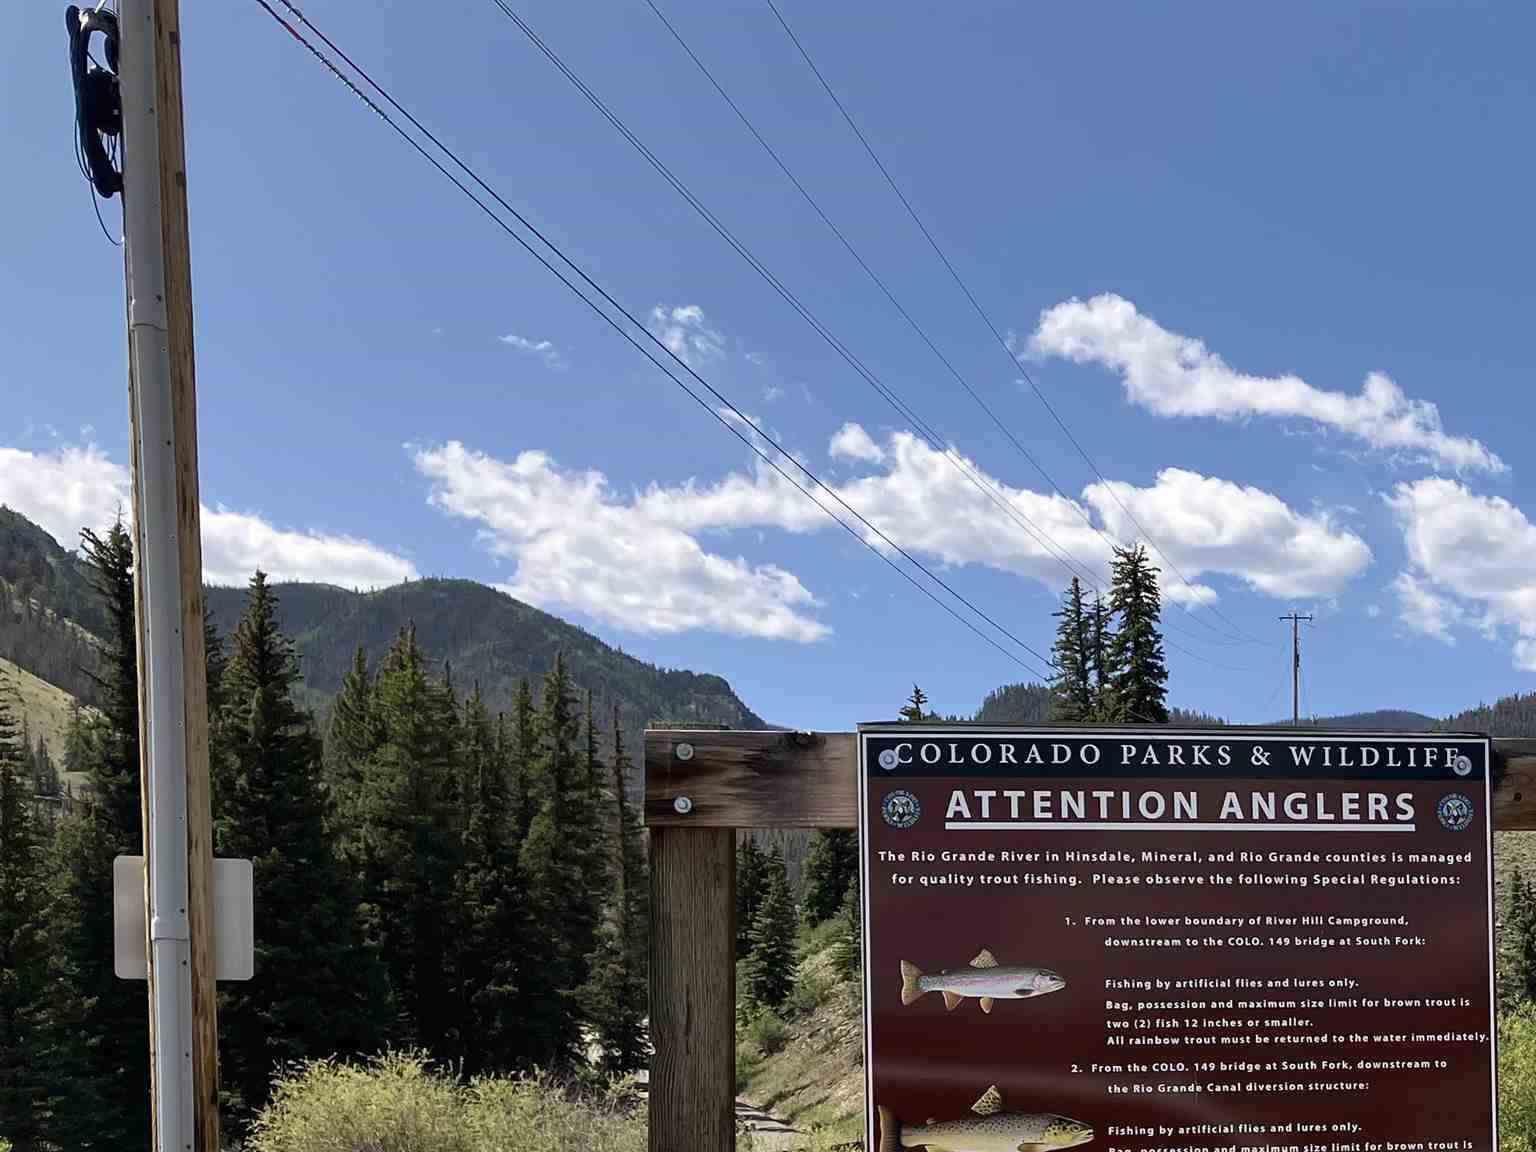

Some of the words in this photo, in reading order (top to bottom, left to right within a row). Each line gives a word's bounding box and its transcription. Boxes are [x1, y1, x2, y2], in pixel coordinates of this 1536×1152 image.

[895, 743, 1101, 765] COLORADO
[1120, 744, 1231, 766] PARKS
[1250, 745, 1271, 766] &
[1288, 746, 1458, 768] WILDLIFE
[945, 790, 1198, 820] ATTENTION
[1219, 791, 1415, 821] ANGLERS
[878, 850, 905, 862] The
[911, 850, 935, 862] Rio
[941, 850, 996, 862] Grande
[1001, 850, 1040, 862] River
[1046, 850, 1060, 862] in
[1065, 850, 1136, 863] Hinsdale,
[1141, 851, 1202, 864] Mineral,
[1208, 851, 1234, 862] and
[1240, 851, 1263, 862] Rio
[1268, 851, 1320, 863] Grande
[1325, 852, 1387, 863] counties
[1392, 852, 1404, 863] is
[1408, 851, 1472, 865] managed
[891, 873, 914, 885] for
[919, 873, 974, 887] quality
[979, 874, 1018, 884] trout
[1023, 873, 1082, 887] fishing.
[1092, 873, 1140, 885] Please
[1145, 873, 1204, 885] observe
[1209, 873, 1233, 885] the
[1238, 873, 1308, 887] following
[1313, 874, 1365, 887] Special
[1370, 874, 1460, 887] Regulations:
[1085, 916, 1116, 926] From
[1120, 916, 1141, 926] the
[1145, 916, 1181, 926] lower
[1184, 916, 1244, 928] boundary
[1248, 916, 1262, 925] of
[1265, 916, 1298, 925] River
[1302, 915, 1323, 925] Hill
[1327, 915, 1409, 927] Campground,
[1104, 937, 1181, 947] downstream
[1185, 938, 1199, 946] to
[1203, 936, 1223, 946] the
[1227, 937, 1264, 946] COLO.
[1269, 937, 1290, 946] 149
[1294, 936, 1335, 948] bridge
[1339, 937, 1351, 946] at
[1355, 936, 1391, 946] South
[1395, 936, 1426, 946] Fork:
[1108, 1084, 1129, 1094] the
[1133, 1083, 1153, 1093] Rio
[1157, 1083, 1202, 1093] Grande
[1206, 1082, 1241, 1092] Canal
[1245, 1081, 1304, 1092] diversion
[1308, 1082, 1369, 1091] structure:
